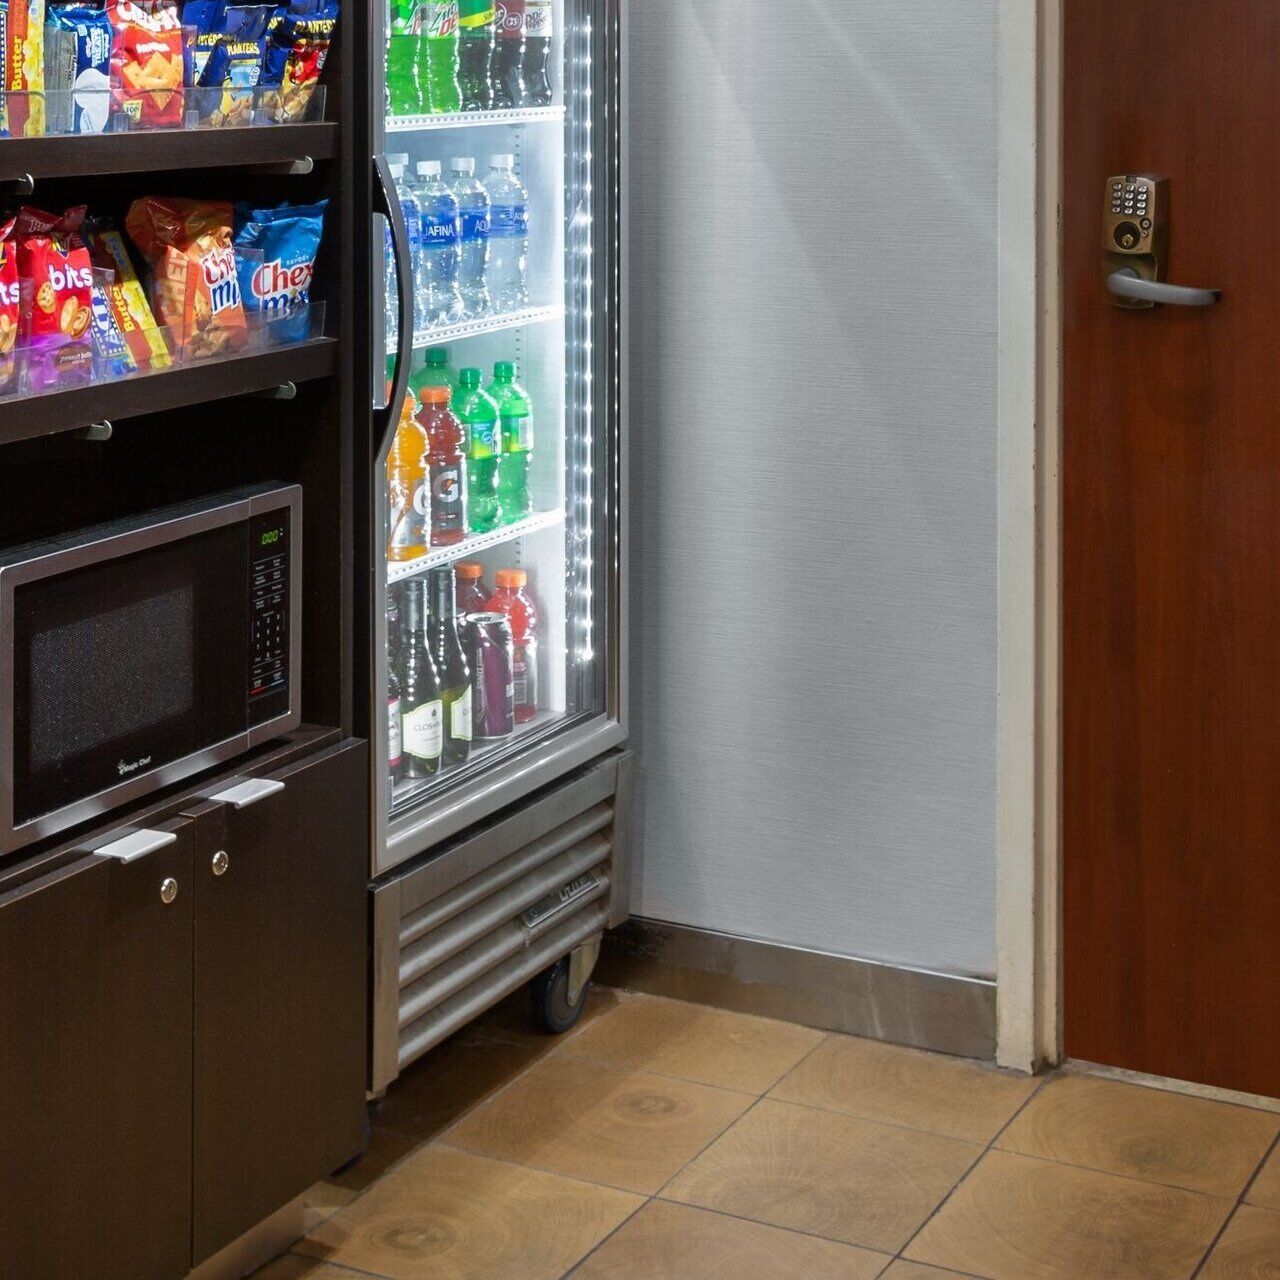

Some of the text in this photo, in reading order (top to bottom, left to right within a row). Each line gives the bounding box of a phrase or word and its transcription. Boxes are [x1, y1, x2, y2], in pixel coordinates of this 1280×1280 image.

[11, 36, 24, 91] Butter
[423, 223, 455, 237] AFINA
[48, 264, 93, 292] bits
[201, 246, 235, 286] Che
[251, 256, 315, 298] Chex
[111, 283, 136, 333] Butter
[212, 279, 240, 313] mi
